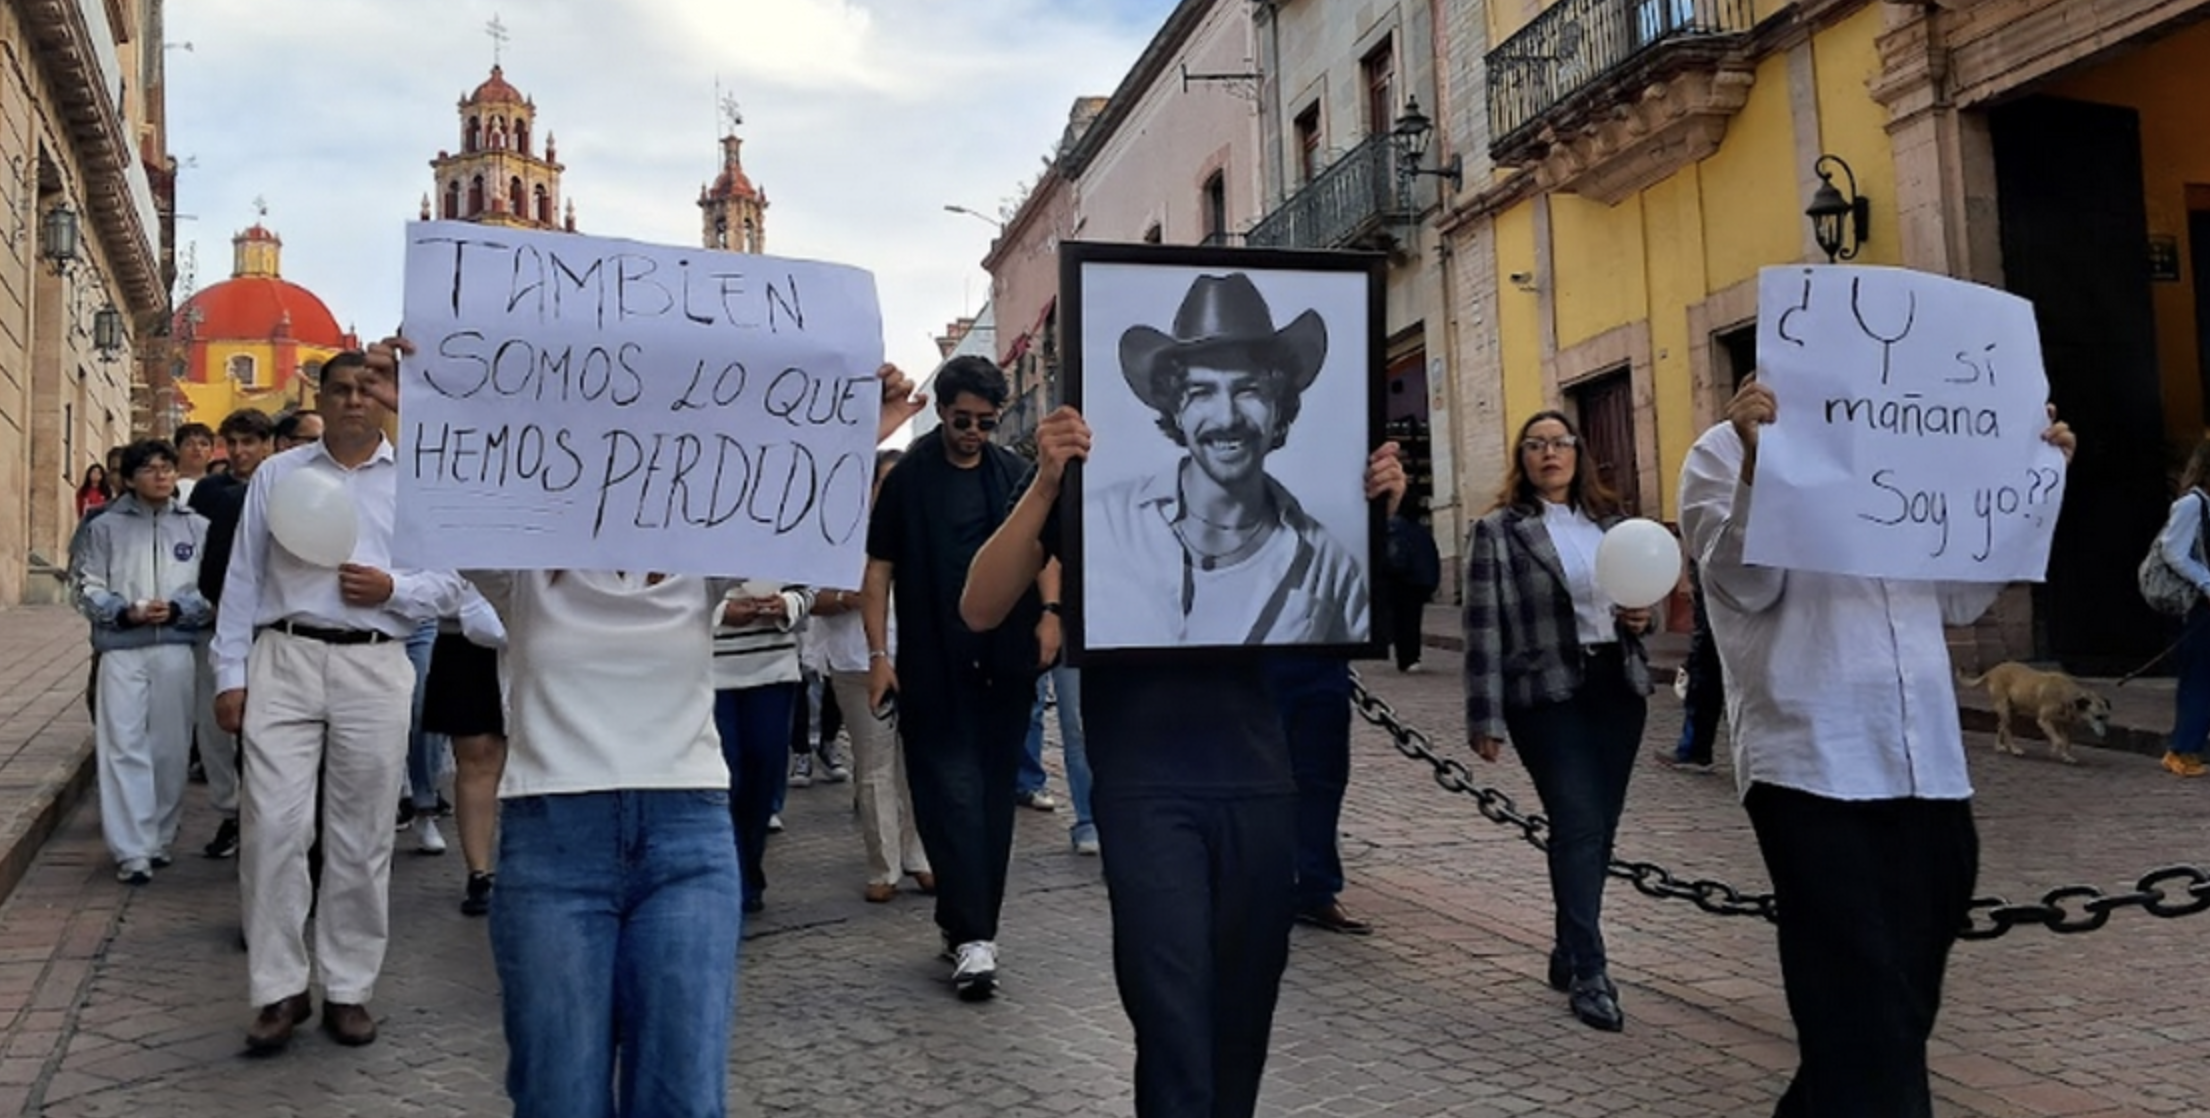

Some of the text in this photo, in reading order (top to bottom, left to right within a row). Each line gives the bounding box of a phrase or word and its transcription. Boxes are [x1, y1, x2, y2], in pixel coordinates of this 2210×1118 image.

[423, 331, 876, 426] SOMOS LO QUE
[1825, 393, 2000, 438] mañana
[414, 422, 583, 493] HEMOS
